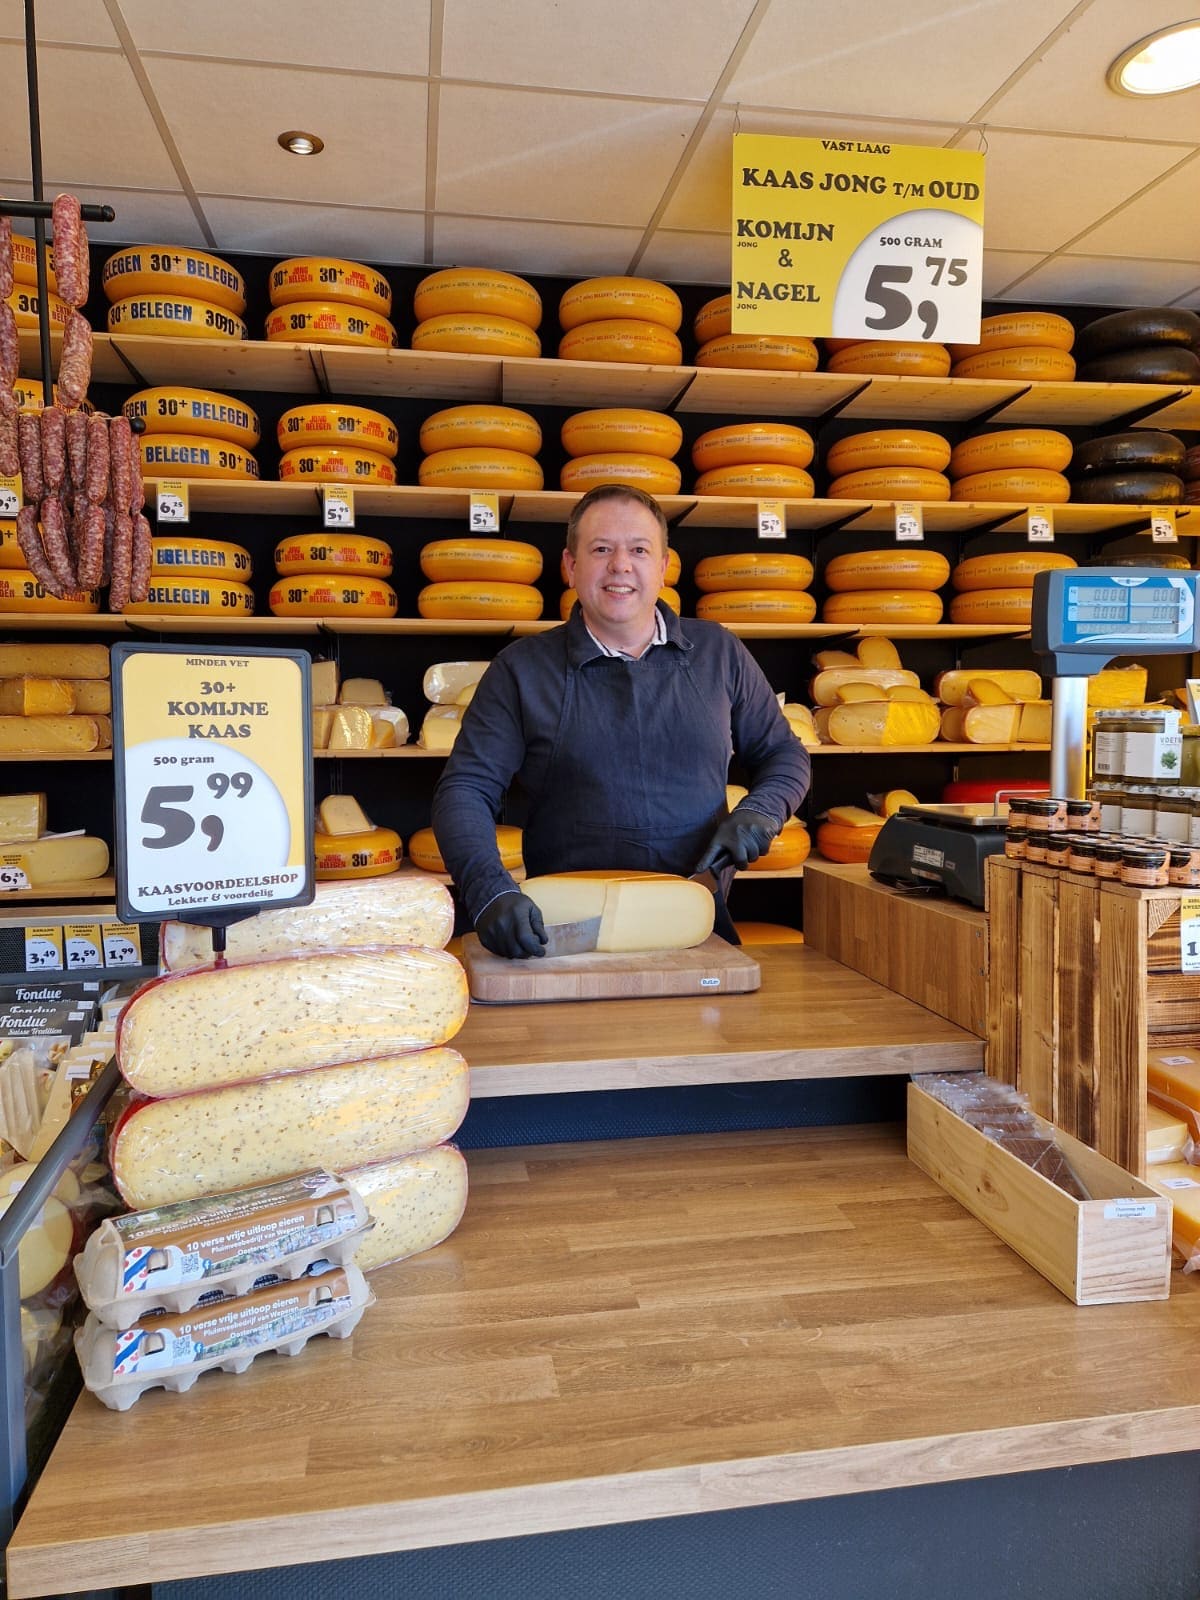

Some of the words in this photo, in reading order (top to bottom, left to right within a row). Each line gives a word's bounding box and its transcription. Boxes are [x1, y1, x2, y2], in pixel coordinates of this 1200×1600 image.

[822, 140, 854, 152] VAST
[857, 143, 890, 154] LAAG
[742, 168, 814, 189] KAAS
[819, 174, 887, 194] JONG
[892, 182, 924, 198] T/M
[928, 180, 980, 200] OUD
[736, 219, 834, 242] KOMIJN
[880, 236, 901, 246] 500
[904, 236, 943, 248] GRAM
[778, 248, 793, 268] &
[186, 258, 239, 292] BELEGEN
[320, 267, 344, 282] 30+
[736, 281, 820, 302] NAGEL
[130, 302, 192, 322] BELEGEN
[290, 314, 312, 330] 30+
[348, 317, 370, 334] 30+
[124, 400, 148, 418] EGEN
[158, 398, 188, 416] 30+
[192, 401, 249, 428] BELEGEN
[338, 416, 362, 432] 30+
[145, 446, 210, 465] BELEGEN
[218, 451, 242, 470] 30+
[299, 457, 320, 474] 30+
[356, 460, 376, 476] 30+
[310, 546, 334, 560] 30+
[148, 587, 210, 605] BELEGEN
[221, 590, 244, 608] 30+
[288, 588, 308, 603] 30+
[342, 589, 365, 604] 30+
[186, 658, 227, 668] MINDER
[229, 660, 248, 668] VET
[200, 681, 236, 695] 30+
[168, 702, 268, 716] KOMIJNE
[188, 724, 251, 738] KAAS
[153, 756, 178, 766] 500
[180, 755, 214, 766] gram
[352, 852, 374, 867] 30+
[138, 873, 298, 897] KAASVOORDEELSHOP
[168, 894, 208, 906] Lekker
[211, 892, 221, 902] &
[224, 888, 274, 900] voordelig
[30, 950, 56, 964] 3,49
[70, 949, 96, 963] 2,59
[108, 948, 134, 961] 1,99
[16, 988, 62, 1000] Fondue
[0, 1014, 48, 1028] Fondue
[31, 1027, 62, 1035] Tradition
[187, 1242, 199, 1252] 10
[200, 1236, 224, 1248] verse
[226, 1230, 246, 1242] vrije
[247, 1222, 278, 1236] uitloop
[278, 1216, 304, 1228] eieren
[212, 1234, 263, 1254] Pluimveebedrijf
[180, 1324, 192, 1334] 10
[193, 1318, 218, 1330] verse
[218, 1312, 238, 1324] vrije
[240, 1304, 270, 1317] uitloop
[272, 1296, 299, 1308] eieren
[204, 1318, 256, 1336] Pluimveebedrijf
[258, 1314, 269, 1322] van
